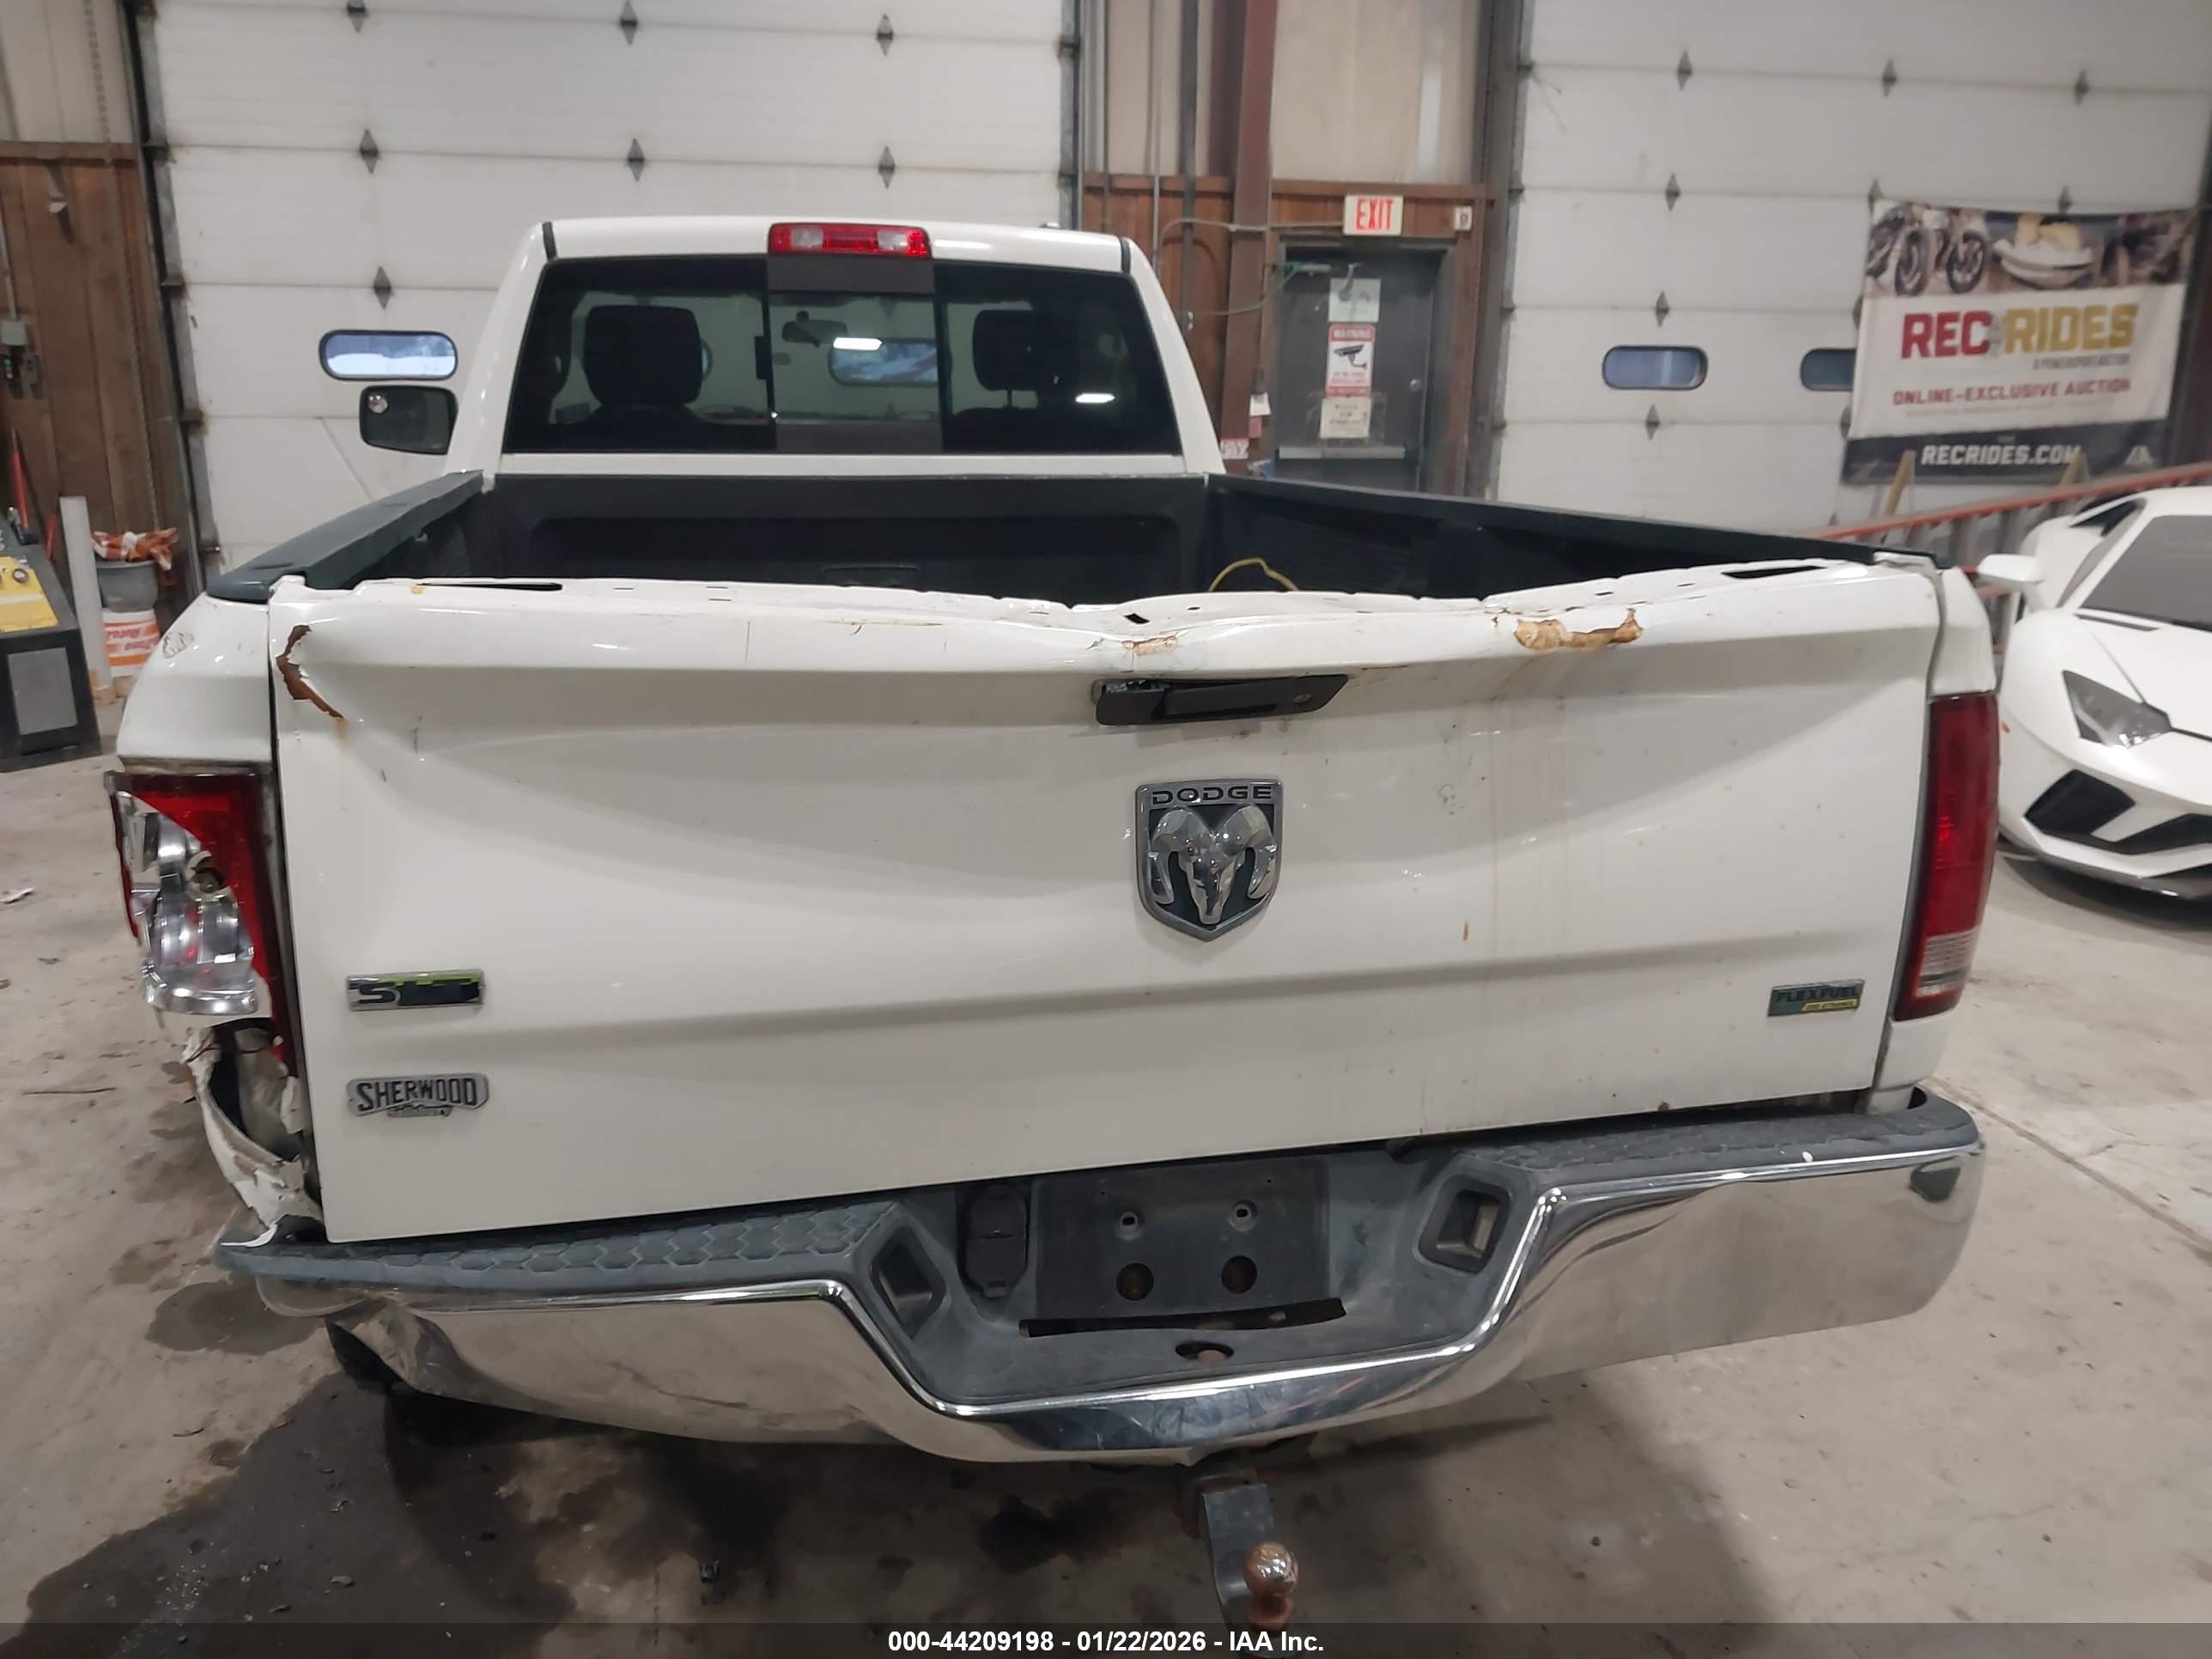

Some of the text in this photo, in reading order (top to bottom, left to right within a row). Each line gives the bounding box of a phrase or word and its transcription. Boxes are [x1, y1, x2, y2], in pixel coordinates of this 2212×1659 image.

[1355, 198, 1395, 231] EXIT
[1901, 303, 2139, 359] REC RIDES
[1893, 378, 2131, 405] ONLINE-EXCLUSIVE AUCTION
[1152, 785, 1272, 805] DODGE
[356, 1078, 478, 1112] SHERWOOD
